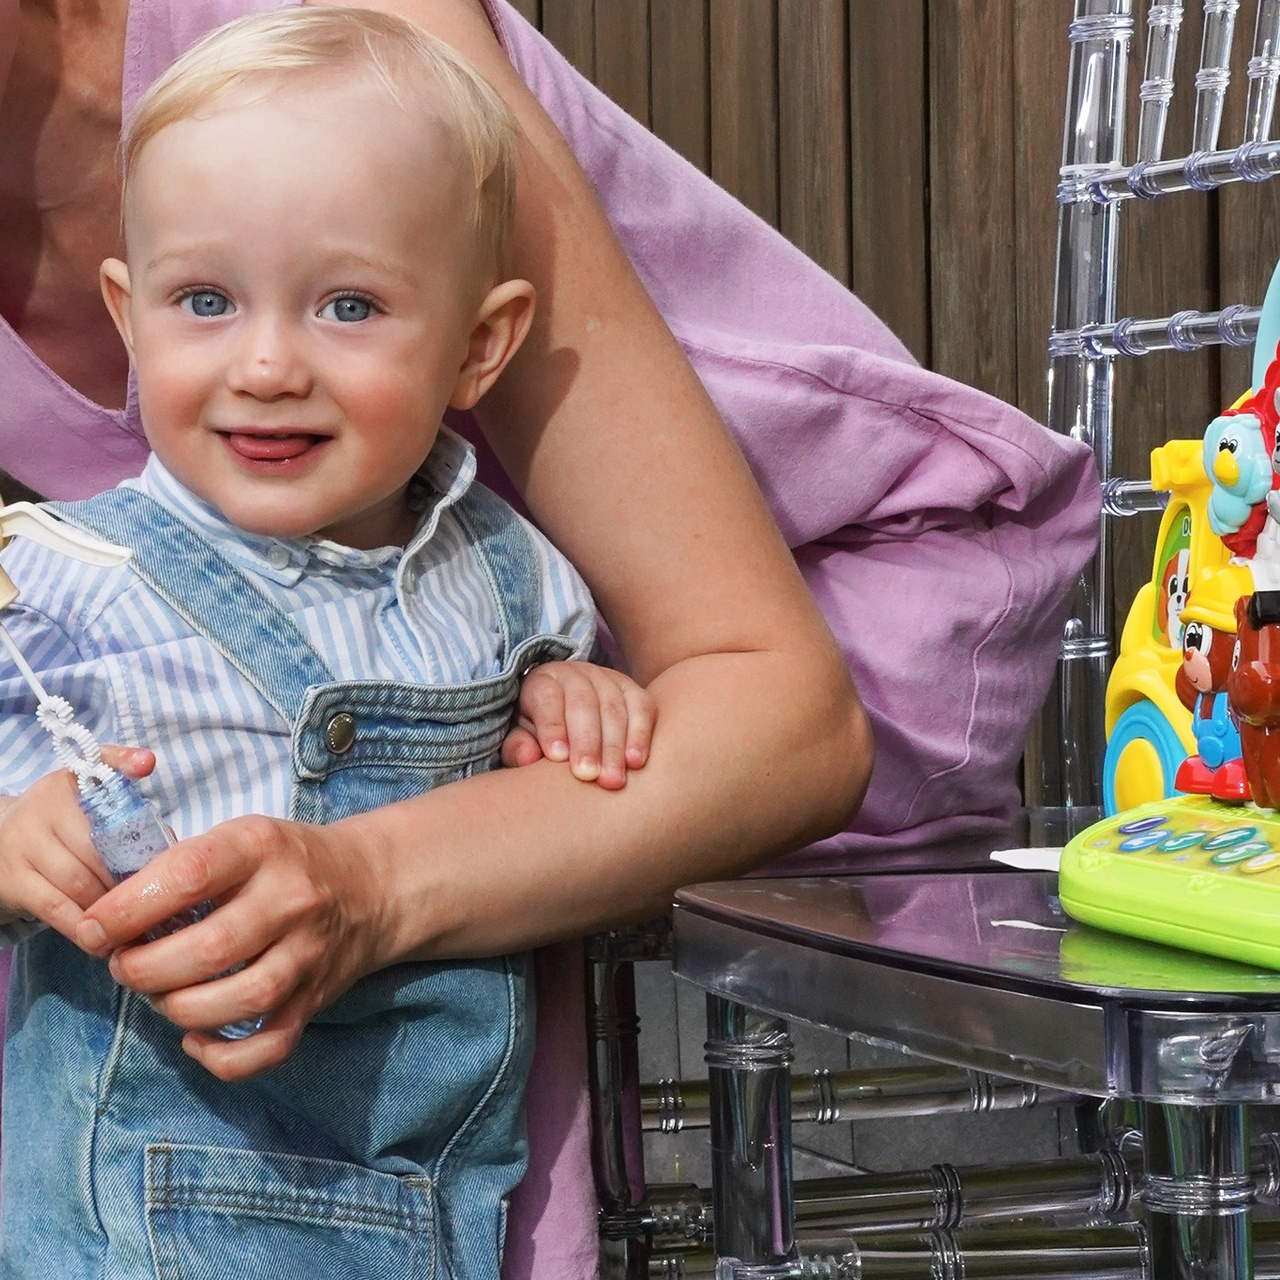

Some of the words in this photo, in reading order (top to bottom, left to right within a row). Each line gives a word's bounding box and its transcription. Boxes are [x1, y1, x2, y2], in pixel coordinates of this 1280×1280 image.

[1126, 830, 1168, 846] 2
[1164, 831, 1207, 847] 3
[1217, 843, 1267, 859] 5
